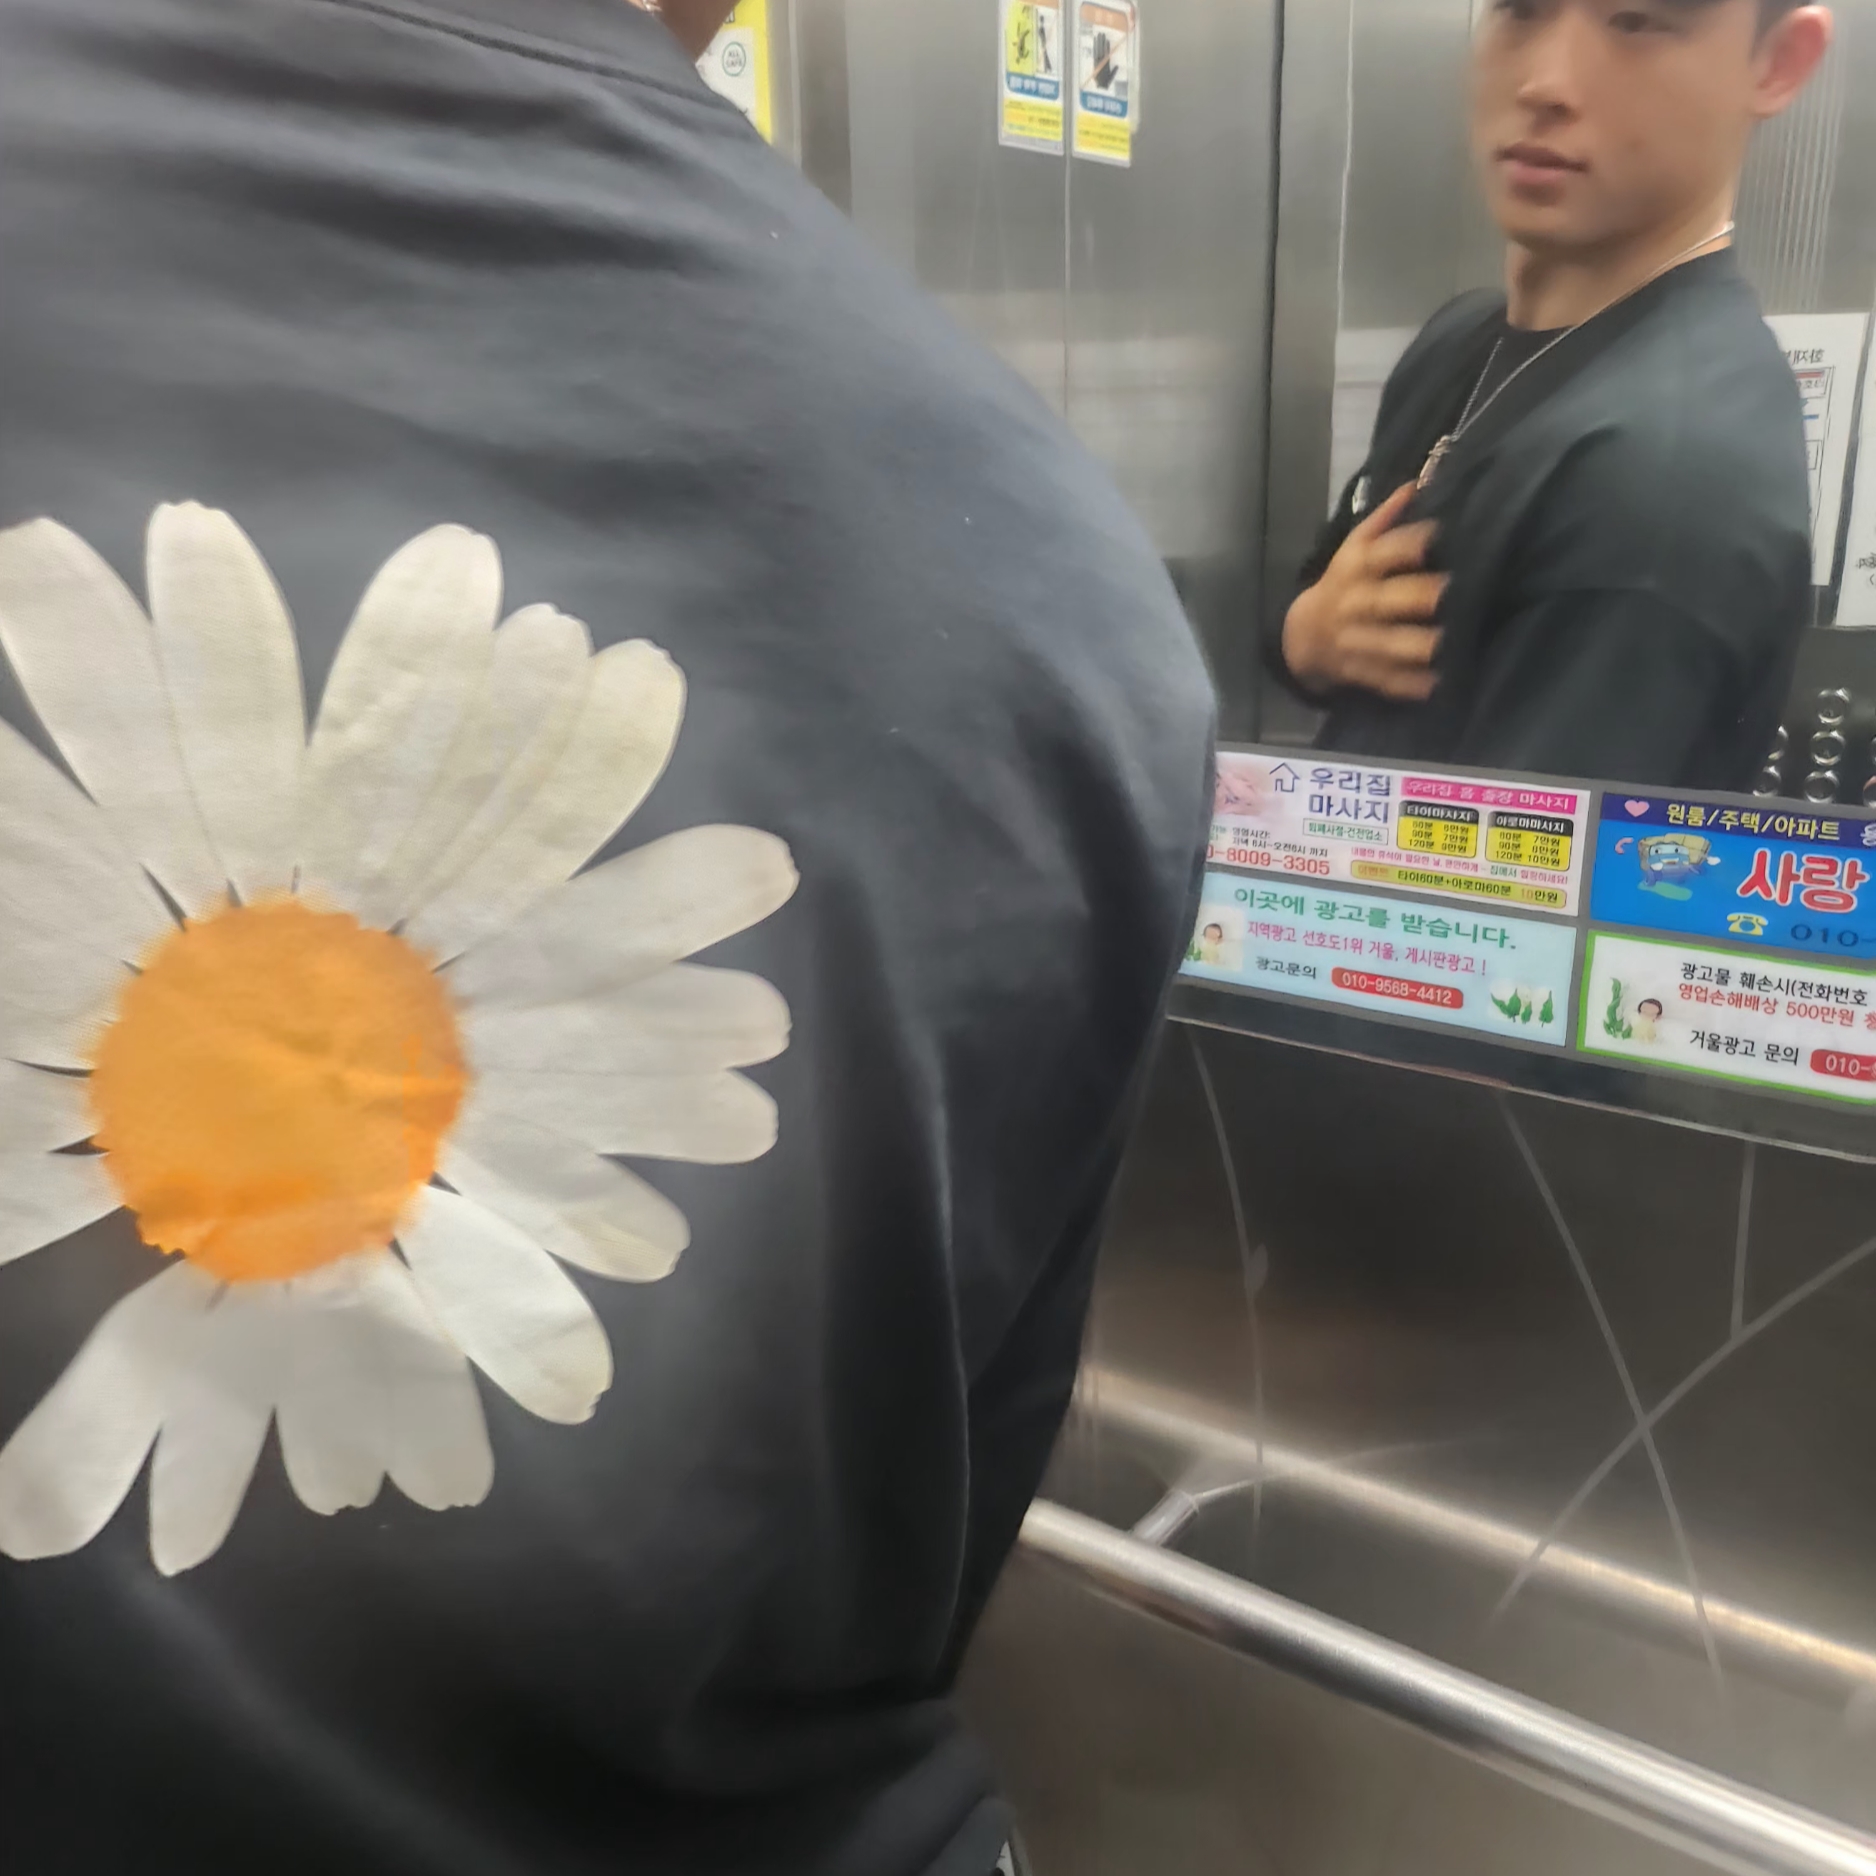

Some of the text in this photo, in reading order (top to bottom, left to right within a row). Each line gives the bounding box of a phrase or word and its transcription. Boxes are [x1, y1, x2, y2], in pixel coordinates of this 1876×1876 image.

[1310, 767, 1391, 797] 우리집
[1407, 780, 1452, 798] 우리집
[1481, 788, 1513, 805] 출장
[1519, 793, 1570, 811] 마사지
[1308, 794, 1389, 824] 마사지
[1406, 804, 1471, 822] 타이마사지
[1666, 803, 1841, 841] 원룸/주택/아파트
[1443, 833, 1468, 844] 7만원
[1496, 815, 1565, 834] 아로마마사지
[1309, 848, 1329, 858] 까지
[1408, 838, 1434, 850] 120분
[1533, 835, 1560, 847] 7만원
[1490, 864, 1518, 879] 집에서
[1495, 850, 1560, 868] 120분 10만원
[1398, 870, 1511, 896] 타이60분+아로마60분
[1521, 887, 1558, 904] 10만원
[1736, 847, 1871, 914] 사랑
[1234, 888, 1517, 950] 이곳에 광고를 받습니다.
[1247, 921, 1297, 943] 지역광고
[1302, 930, 1363, 956] 선호도1위
[1405, 946, 1476, 974] 게시판광고
[1255, 956, 1317, 980] 광고문의
[1341, 971, 1453, 1005] 010-9568-4412
[1680, 962, 1868, 1007] 광고물 훼손시(전화번호
[1678, 982, 1779, 1016] 영업손해배상
[1786, 1001, 1855, 1028] 500만원
[1689, 1029, 1800, 1066] 거울광고 문의
